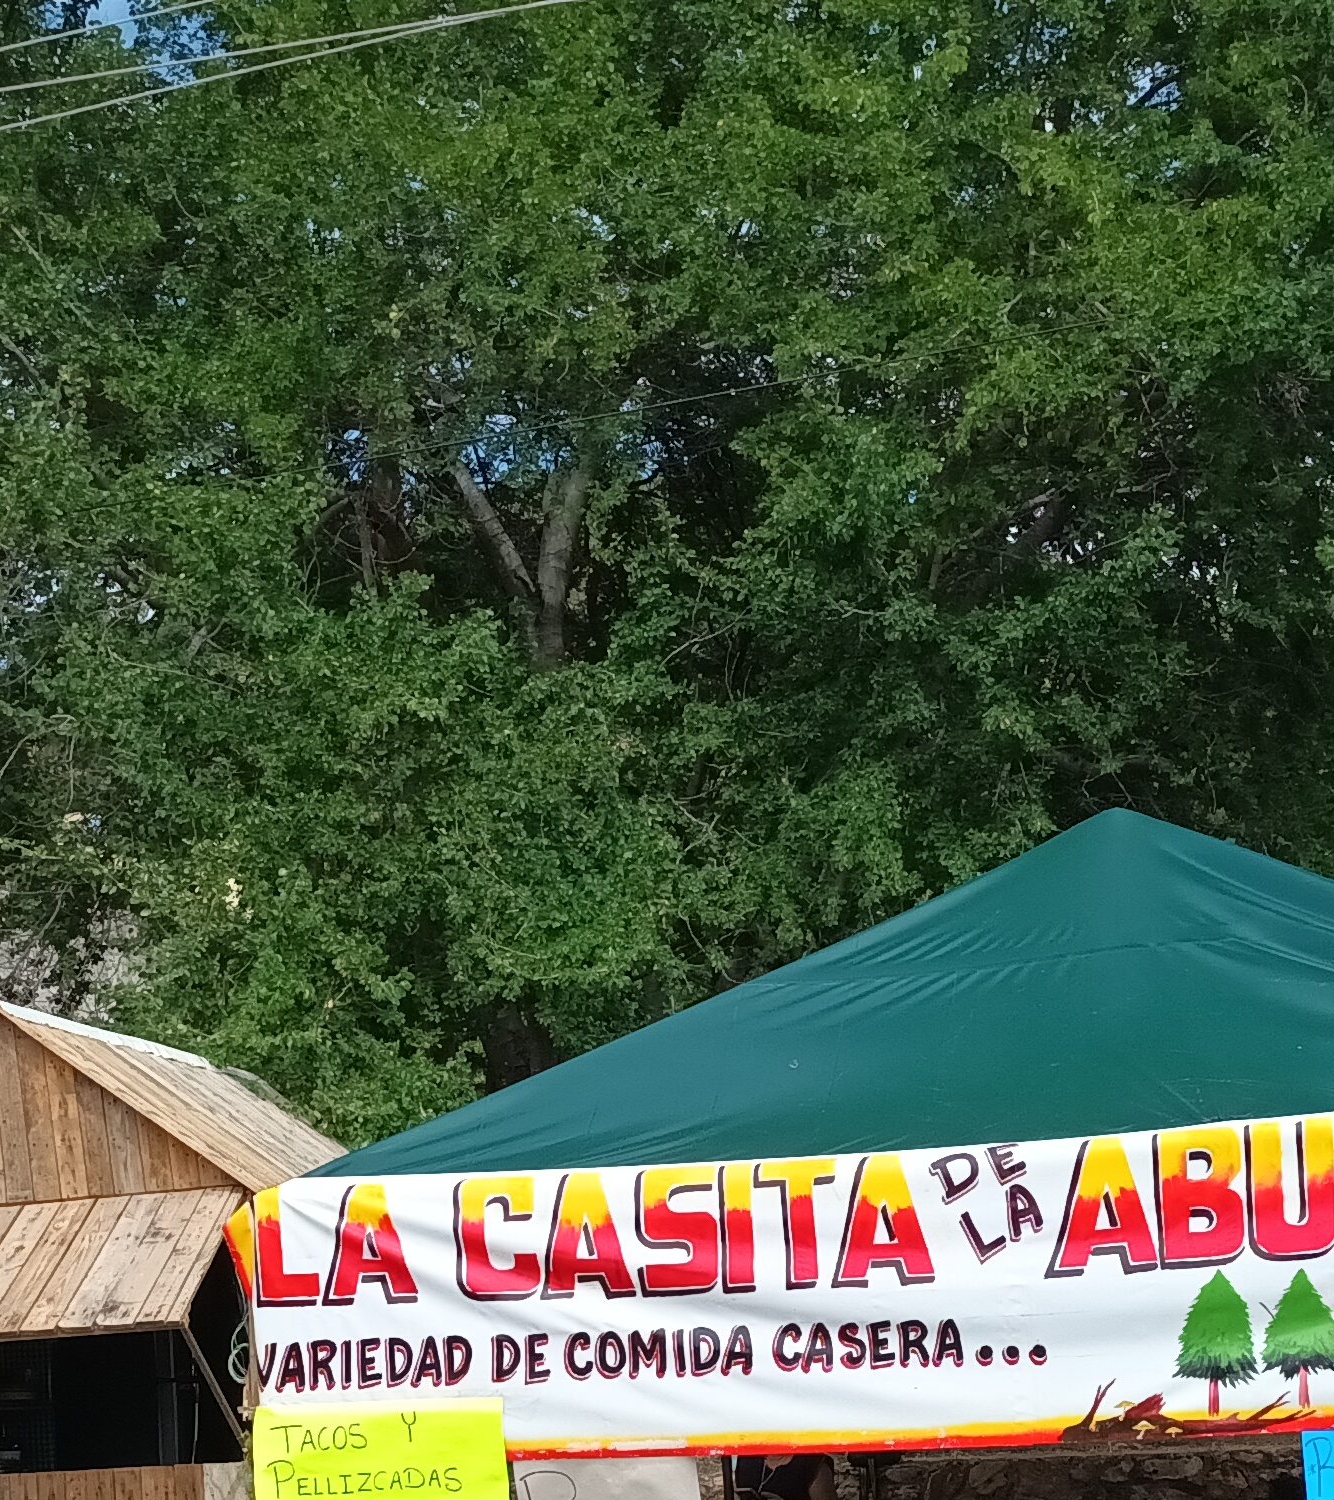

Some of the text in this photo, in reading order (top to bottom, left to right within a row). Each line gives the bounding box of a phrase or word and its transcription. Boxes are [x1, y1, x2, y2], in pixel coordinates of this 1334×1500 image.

[929, 1143, 1027, 1205] DE
[256, 1183, 419, 1308] LA
[453, 1153, 935, 1301] CASITA
[959, 1183, 1043, 1265] LA
[257, 1334, 473, 1393] VARIEDAD
[491, 1332, 551, 1385] DE
[563, 1325, 753, 1380] COMIDA
[270, 1411, 417, 1453] TACOS Y
[267, 1460, 463, 1498] PELLIZCADAS
